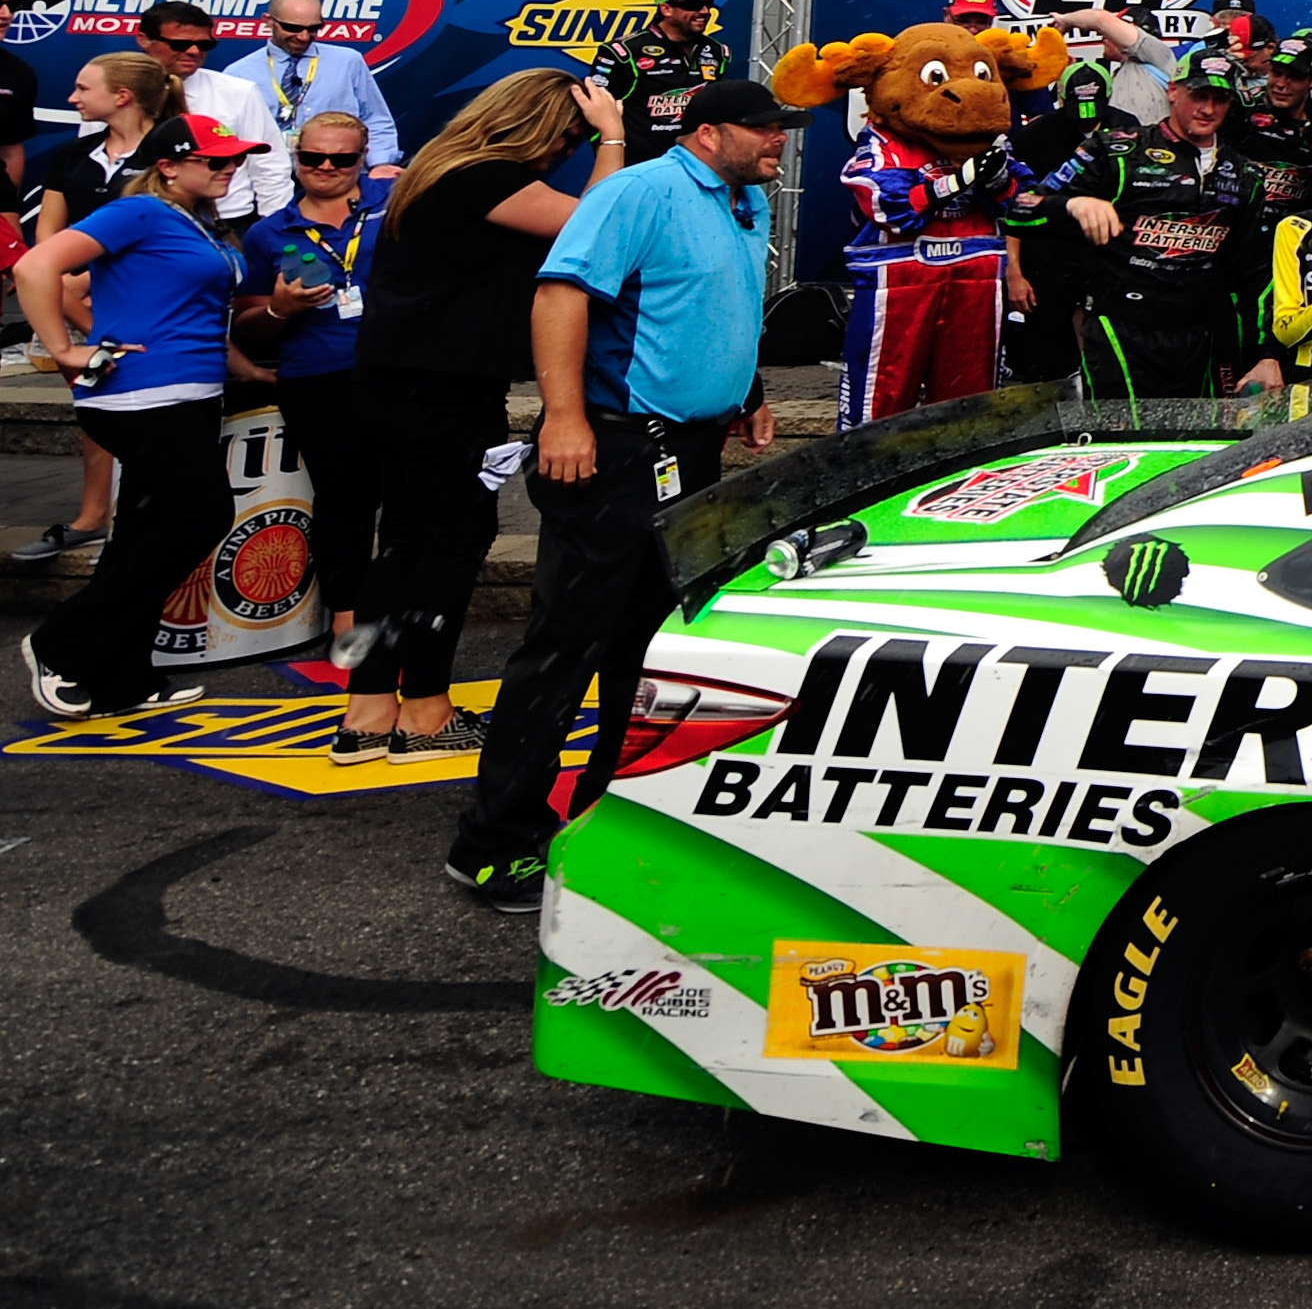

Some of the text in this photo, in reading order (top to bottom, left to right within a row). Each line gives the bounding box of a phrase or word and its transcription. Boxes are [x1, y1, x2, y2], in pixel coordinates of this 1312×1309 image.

[927, 242, 962, 257] MILO
[216, 520, 260, 581] A FINE
[233, 590, 302, 619] BEER
[693, 761, 1184, 848] BATTERIES
[809, 963, 845, 976] PEANUT
[674, 988, 711, 998] JOE
[1108, 896, 1179, 1086] EAGLE
[656, 998, 710, 1008] GIBBS
[641, 1008, 709, 1018] RACING
